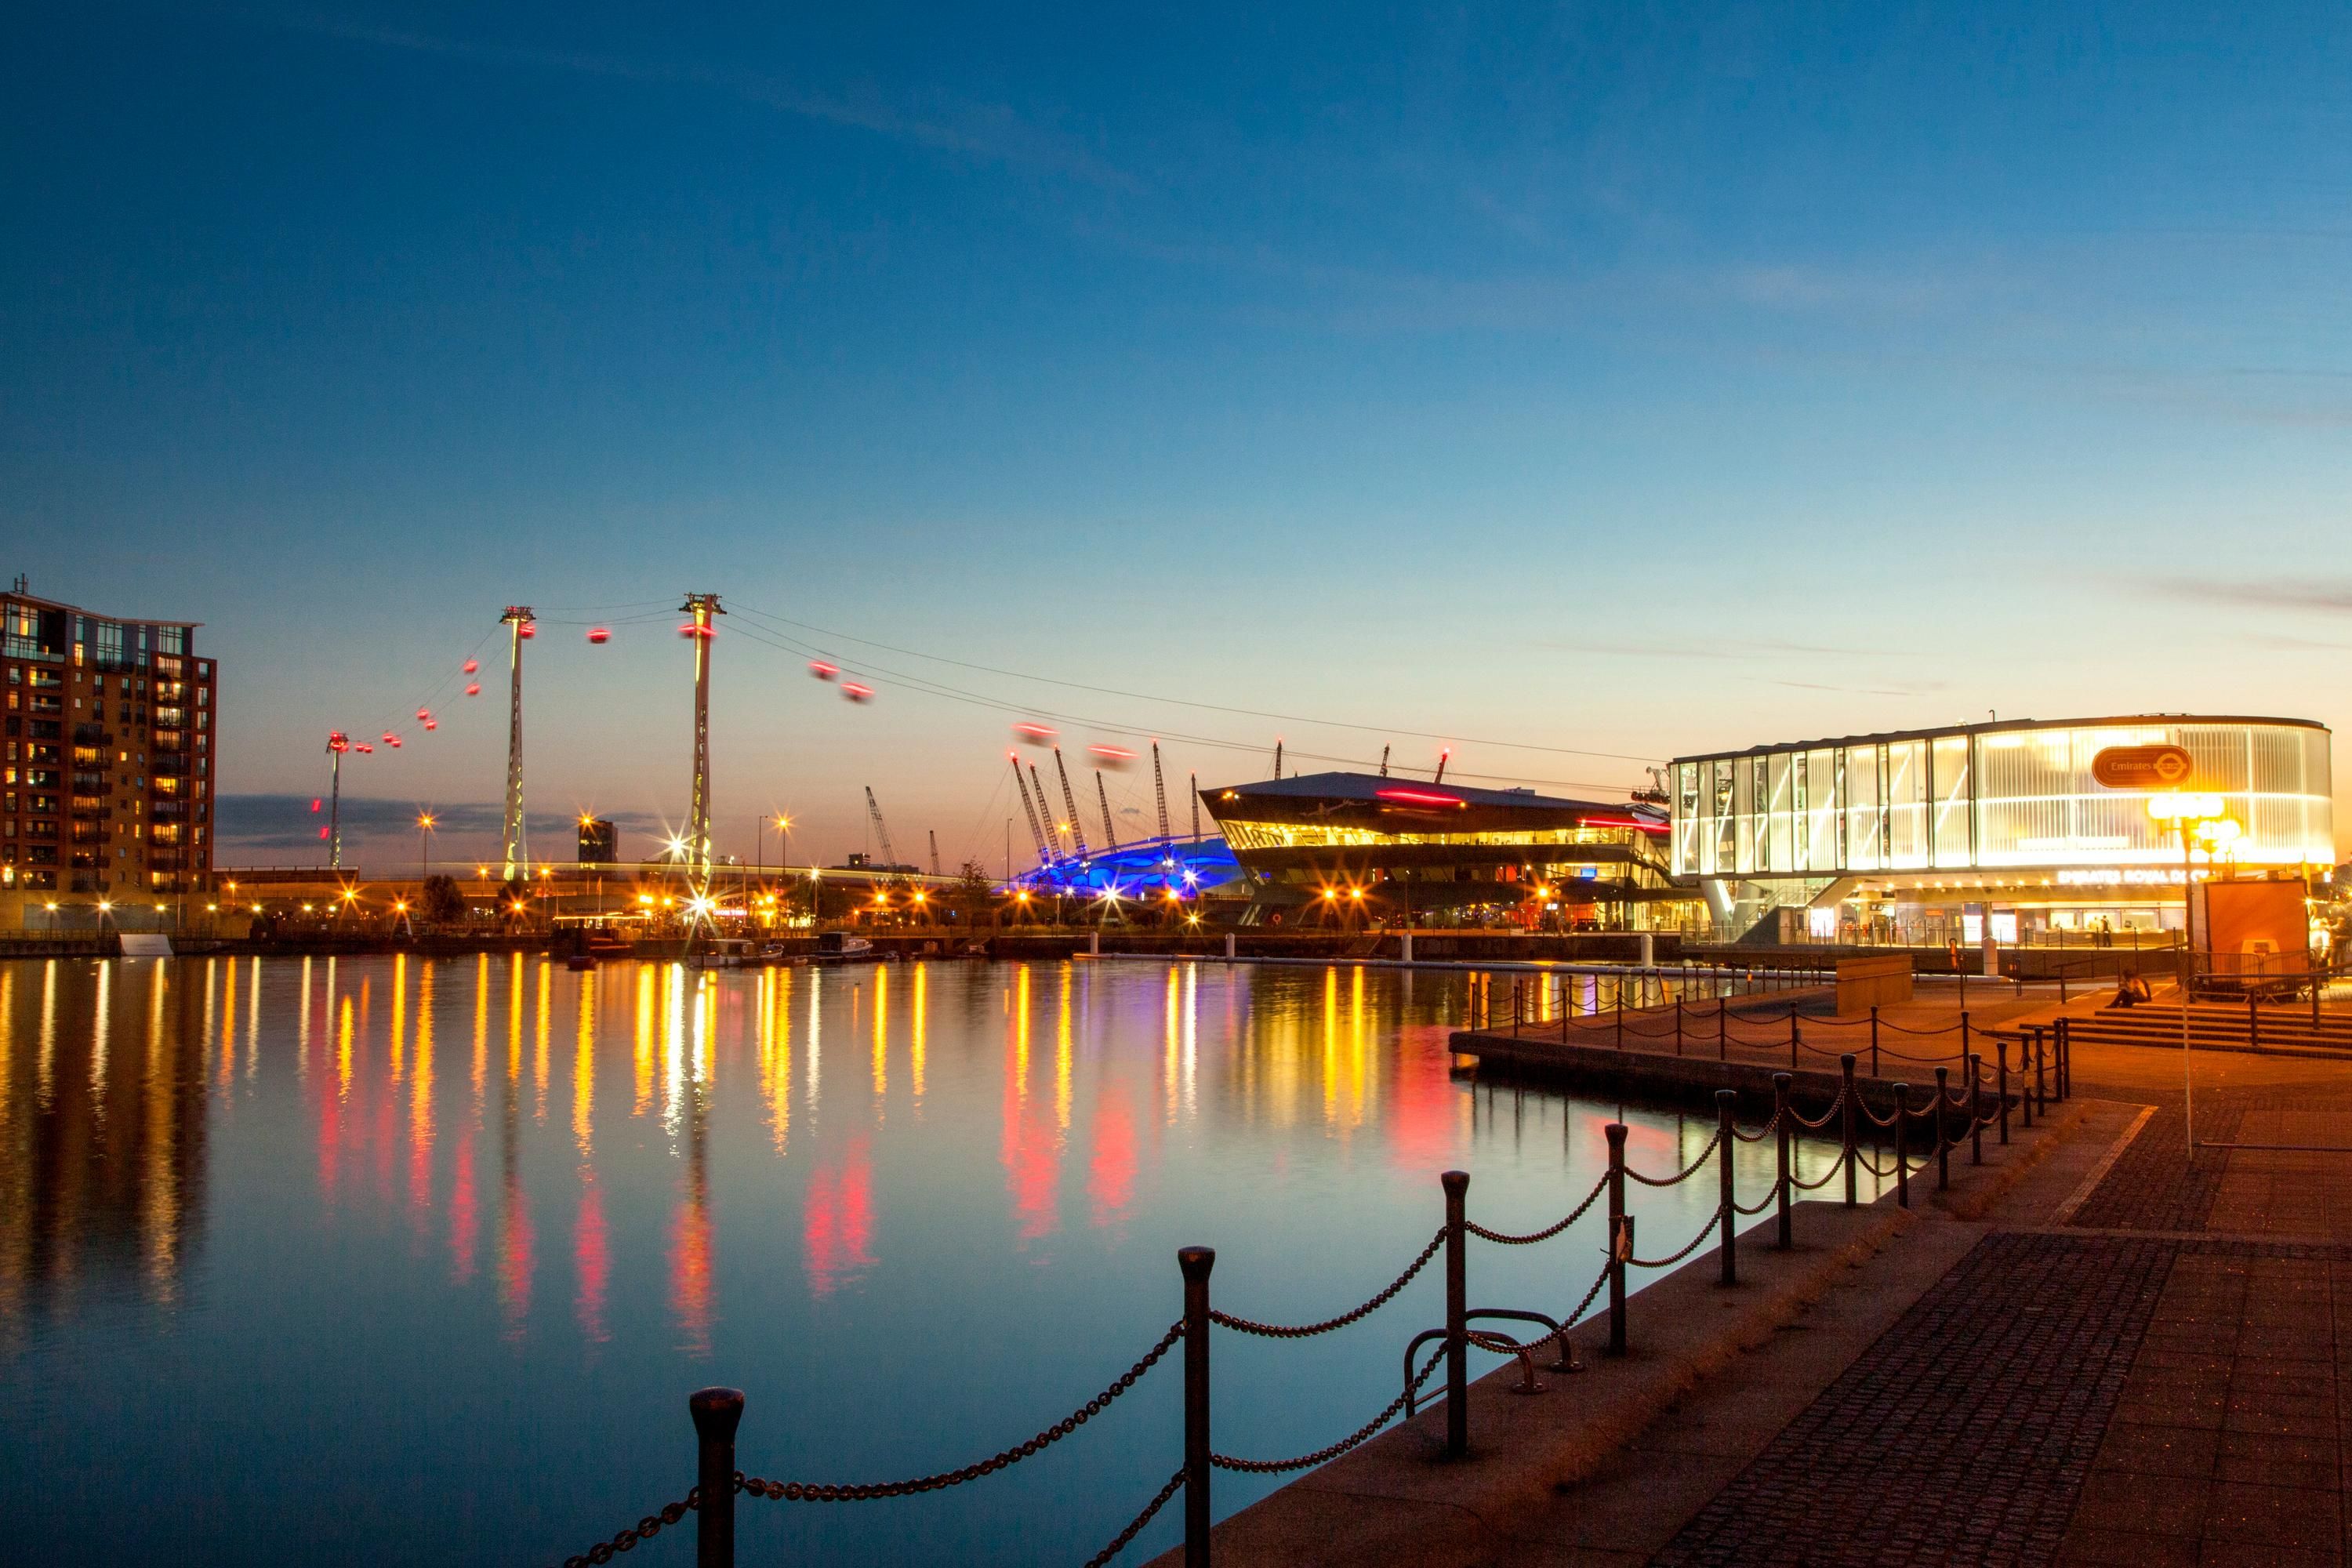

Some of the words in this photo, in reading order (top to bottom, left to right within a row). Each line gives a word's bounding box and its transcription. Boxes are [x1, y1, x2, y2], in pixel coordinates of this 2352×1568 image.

[2111, 761, 2152, 771] Emirates
[2057, 869, 2121, 884] EMIRATES
[2123, 869, 2169, 884] ROYAL
